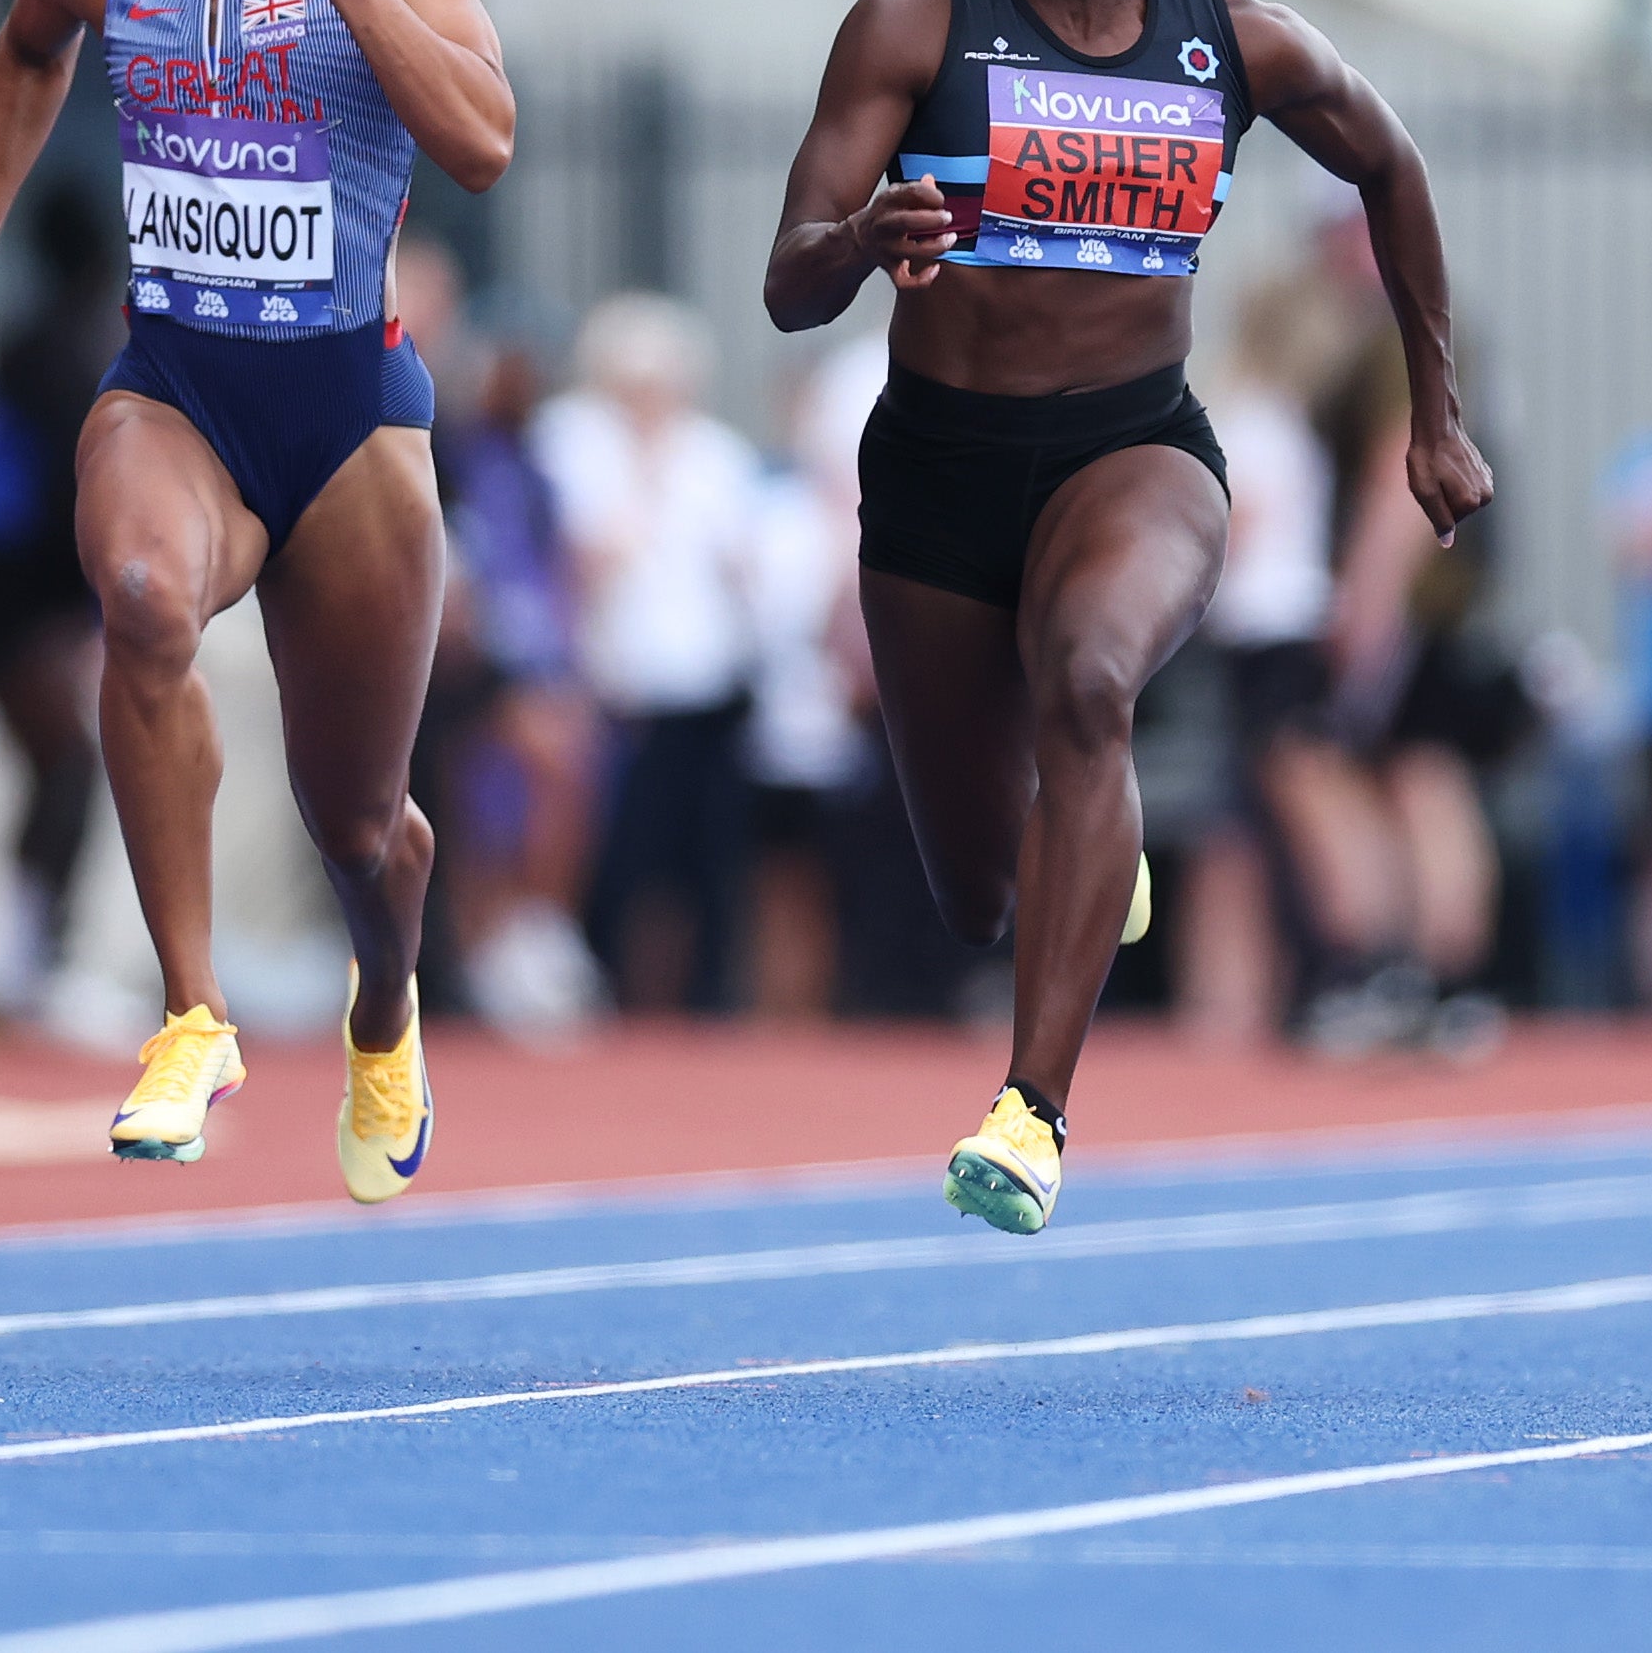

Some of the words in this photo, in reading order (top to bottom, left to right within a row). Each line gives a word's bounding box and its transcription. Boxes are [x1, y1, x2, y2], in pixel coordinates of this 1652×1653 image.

[244, 24, 306, 46] Novuna
[964, 51, 1041, 62] RONHILL
[126, 43, 298, 103] GREAT
[1013, 78, 1192, 127] Novuna
[136, 120, 296, 174] Novuna
[1013, 130, 1197, 184] ASHER
[1021, 178, 1185, 229] SMITH
[126, 188, 322, 261] LANSIQUOT
[1053, 227, 1146, 242] BIRMINGHAM
[1079, 238, 1108, 253] VITA
[1076, 250, 1113, 266] COCO
[136, 280, 167, 297] VITA
[171, 270, 258, 290] BIRMINGHAM
[196, 290, 225, 306] VITA
[262, 294, 294, 311] VITA
[193, 304, 229, 319] COCO
[259, 309, 298, 322] COCO
